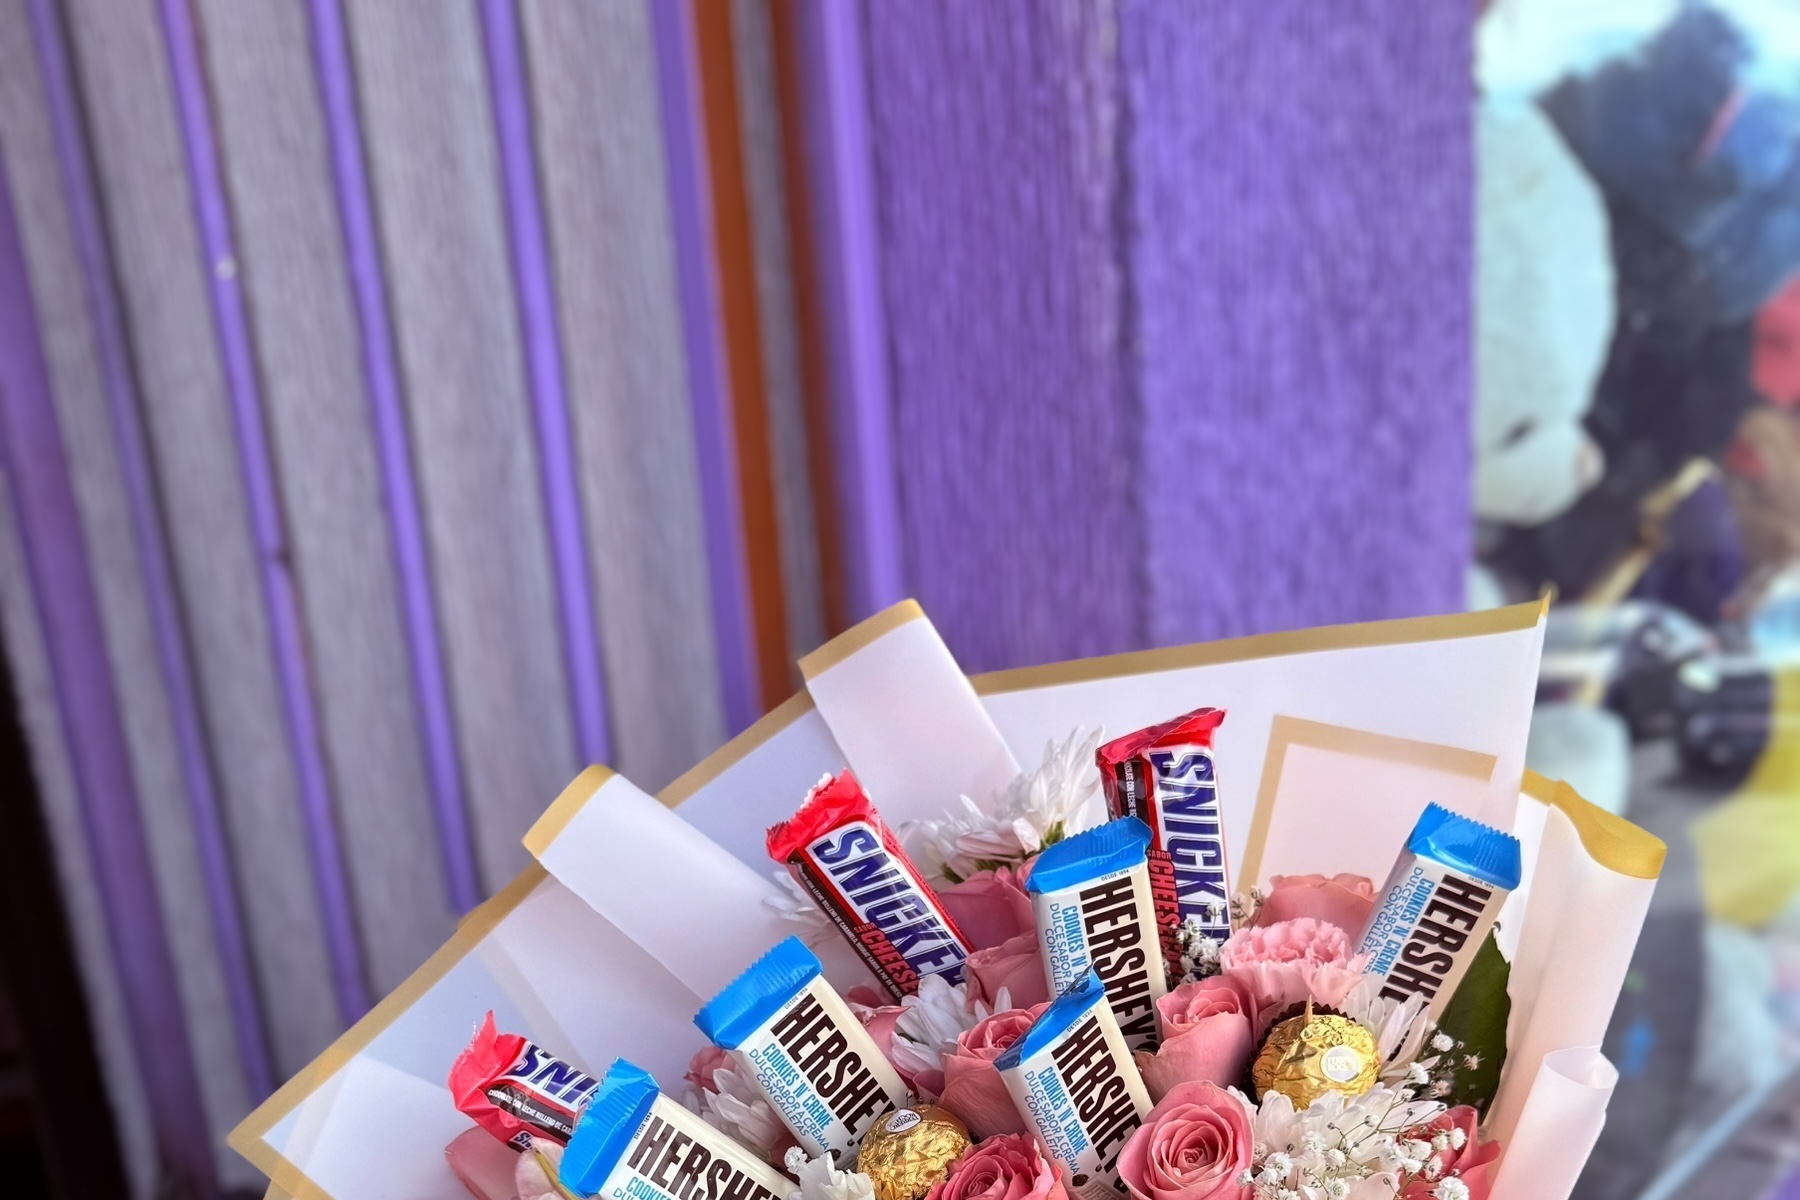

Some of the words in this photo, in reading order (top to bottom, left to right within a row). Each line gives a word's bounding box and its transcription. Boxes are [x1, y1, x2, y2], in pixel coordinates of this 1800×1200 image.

[1100, 872, 1118, 882] DESDE
[1398, 866, 1422, 902] DULCE
[1383, 884, 1401, 909] CON
[1399, 877, 1434, 923] COOKIES
[1061, 905, 1084, 953] COOKIES
[1357, 910, 1387, 956] GALLETA
[1377, 903, 1403, 939] SABOR
[1391, 922, 1410, 940] 'N'
[1044, 928, 1056, 953] CON
[1049, 903, 1065, 939] DULCE
[1058, 941, 1071, 978] SABOR
[1371, 939, 1401, 976] CREME
[1373, 939, 1382, 949] A
[858, 929, 919, 995] CHEESE
[784, 996, 799, 1009] DESDE
[748, 1049, 776, 1081] DULCE
[772, 1078, 799, 1111] SABOR
[796, 1109, 806, 1119] A
[801, 1116, 829, 1150] CREMA
[755, 1072, 776, 1095] CON
[772, 1094, 808, 1136] GALLETAS
[761, 1042, 800, 1087] COOKIES
[790, 1080, 809, 1099] 'N'
[801, 1094, 833, 1130] CREME
[1024, 1070, 1046, 1103] DULCE
[1037, 1066, 1068, 1110] COOKIES
[1024, 1094, 1041, 1117] CON
[1035, 1117, 1062, 1159] GALLETAS
[1039, 1102, 1060, 1134] SABOR
[1055, 1105, 1074, 1123] 'N'
[1054, 1133, 1064, 1143] A
[1063, 1120, 1088, 1155] CREME
[1058, 1141, 1080, 1174] CREMA
